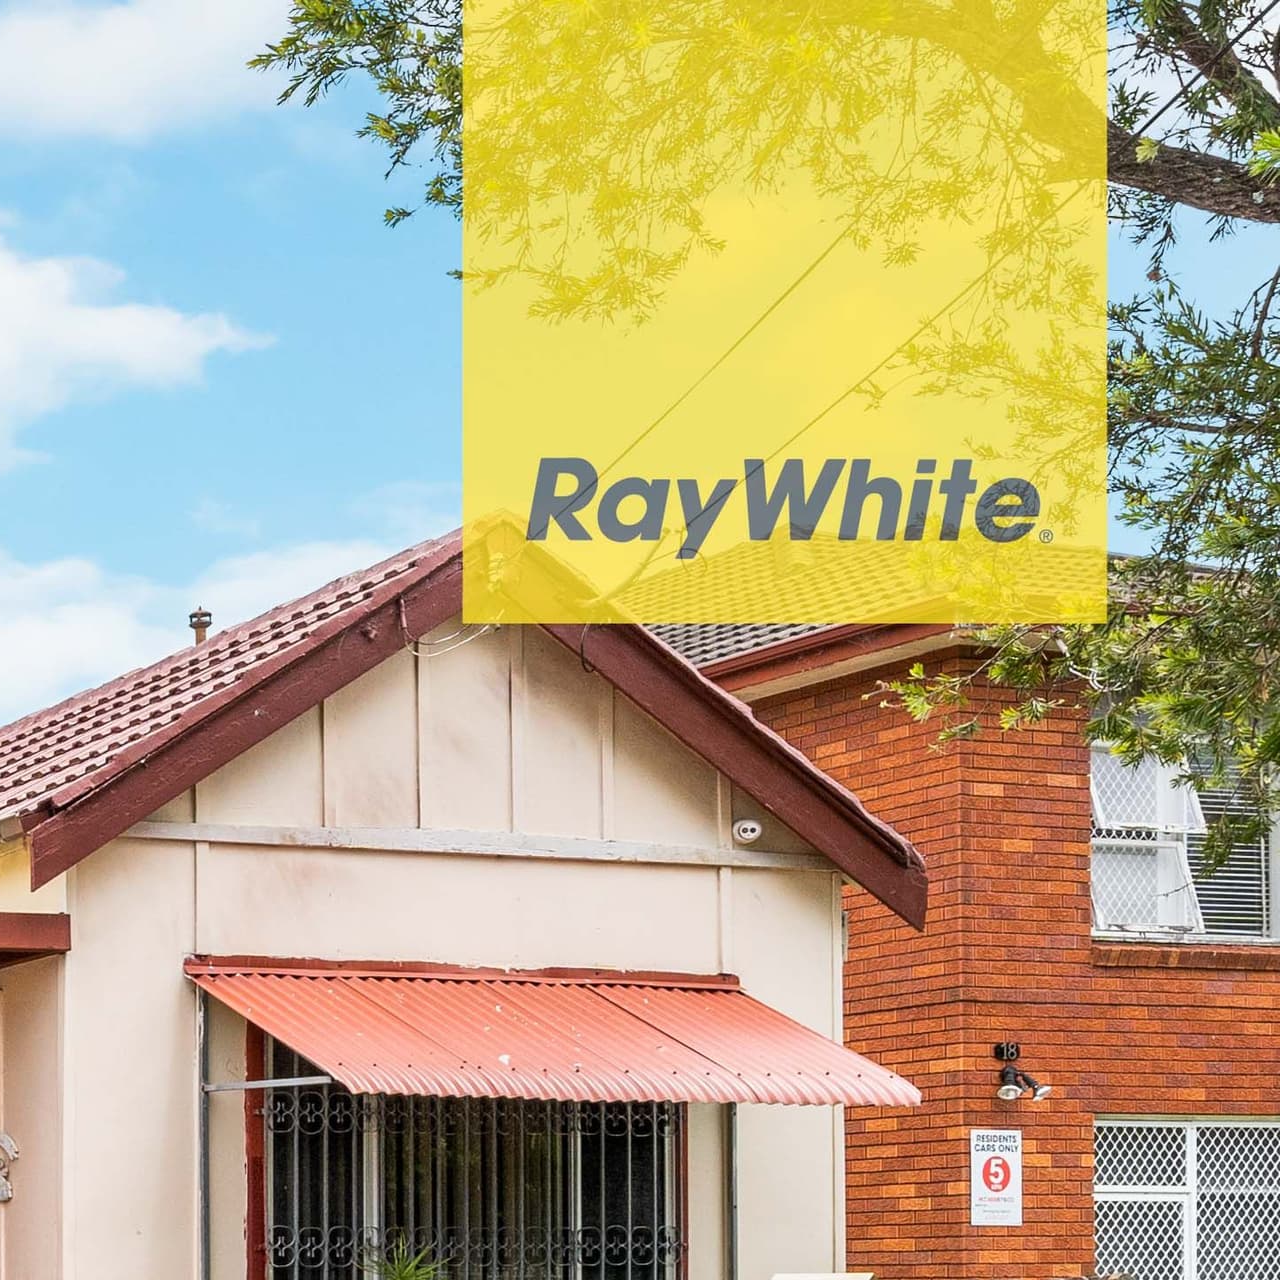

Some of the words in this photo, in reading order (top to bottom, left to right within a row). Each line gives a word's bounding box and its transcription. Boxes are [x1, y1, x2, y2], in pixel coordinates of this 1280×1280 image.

[1001, 1043, 1017, 1060] 18
[976, 1134, 1017, 1143] RESIDENTS
[974, 1144, 996, 1152] CARS
[998, 1144, 1019, 1153] ONLY
[989, 1158, 1005, 1183] 5
